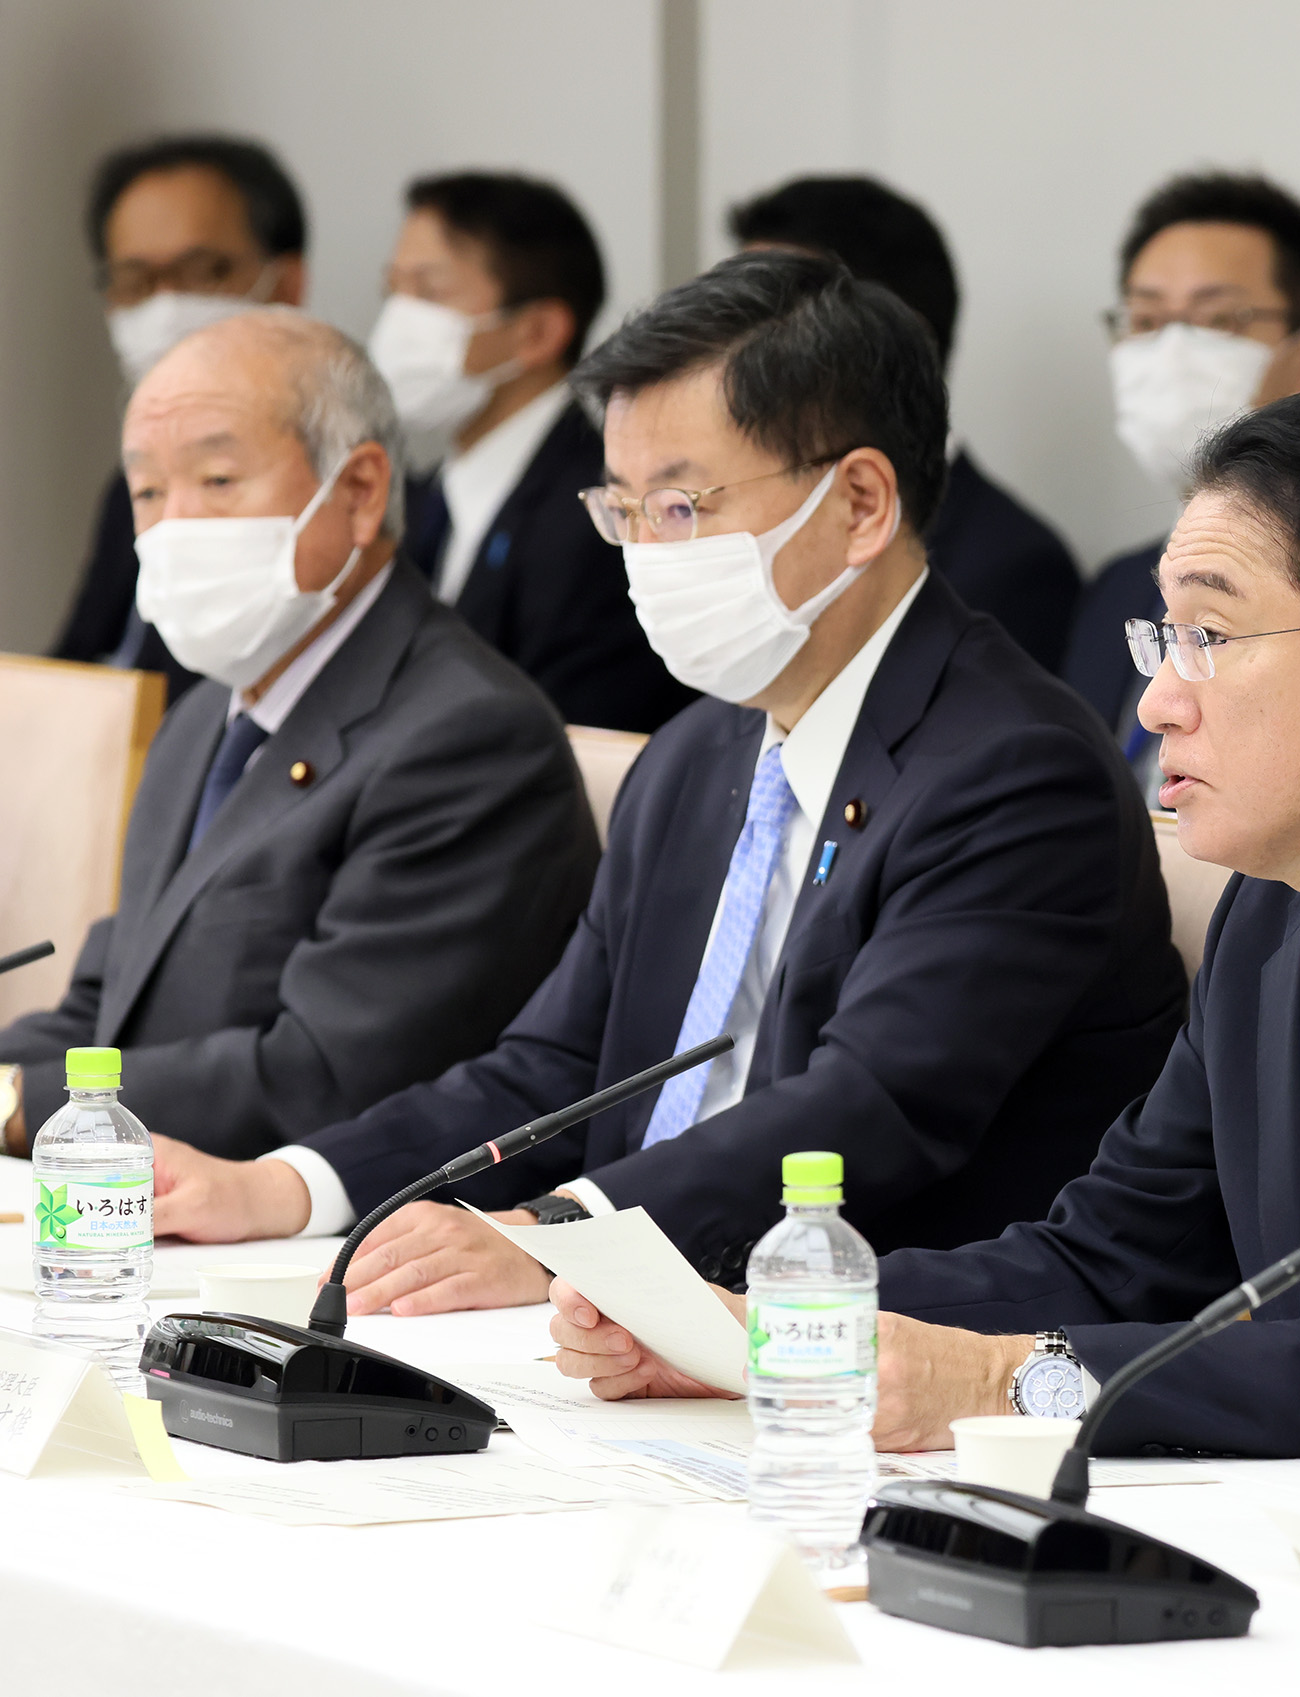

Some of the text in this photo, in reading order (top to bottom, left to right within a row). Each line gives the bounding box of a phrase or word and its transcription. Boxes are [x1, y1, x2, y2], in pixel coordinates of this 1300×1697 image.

[90, 1220, 138, 1230] 日本の天然水
[190, 1408, 233, 1428] audio-technica
